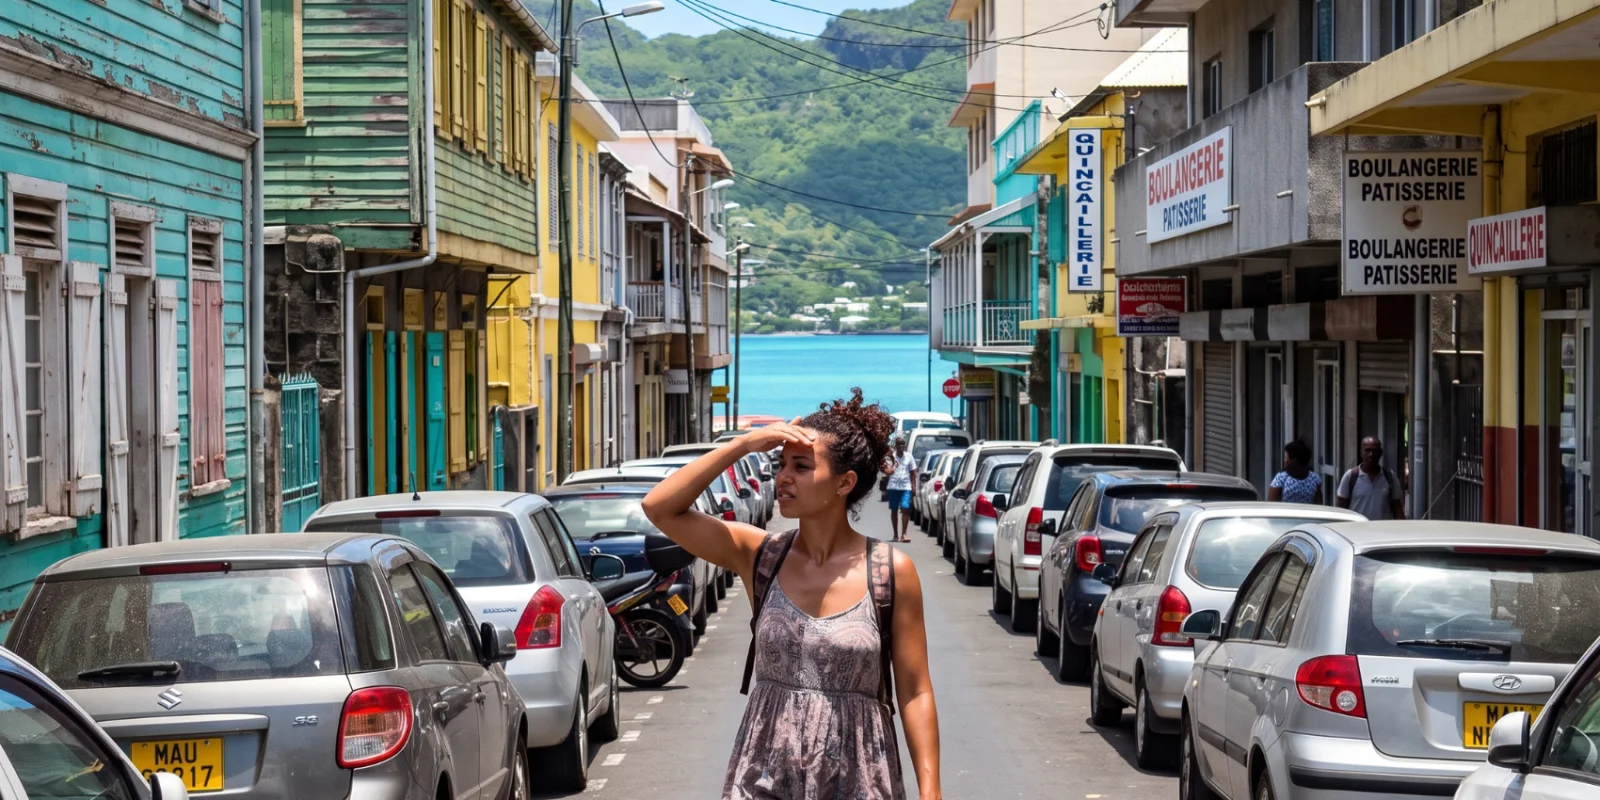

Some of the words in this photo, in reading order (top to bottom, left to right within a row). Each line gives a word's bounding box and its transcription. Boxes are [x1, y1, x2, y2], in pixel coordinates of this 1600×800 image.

[1148, 138, 1224, 206] BOULANGERIE
[1348, 157, 1478, 178] BOULANGERIE
[1361, 181, 1466, 201] PATISSERIE
[1075, 133, 1095, 287] QUINCAILLERIE
[1163, 194, 1206, 232] PATISSERIE
[1348, 238, 1466, 260] BOULANGERIE
[1469, 214, 1544, 269] QUINCAILLERIE
[1363, 264, 1458, 285] PATISSERIE
[943, 385, 960, 393] STOP
[154, 742, 197, 765] MAU
